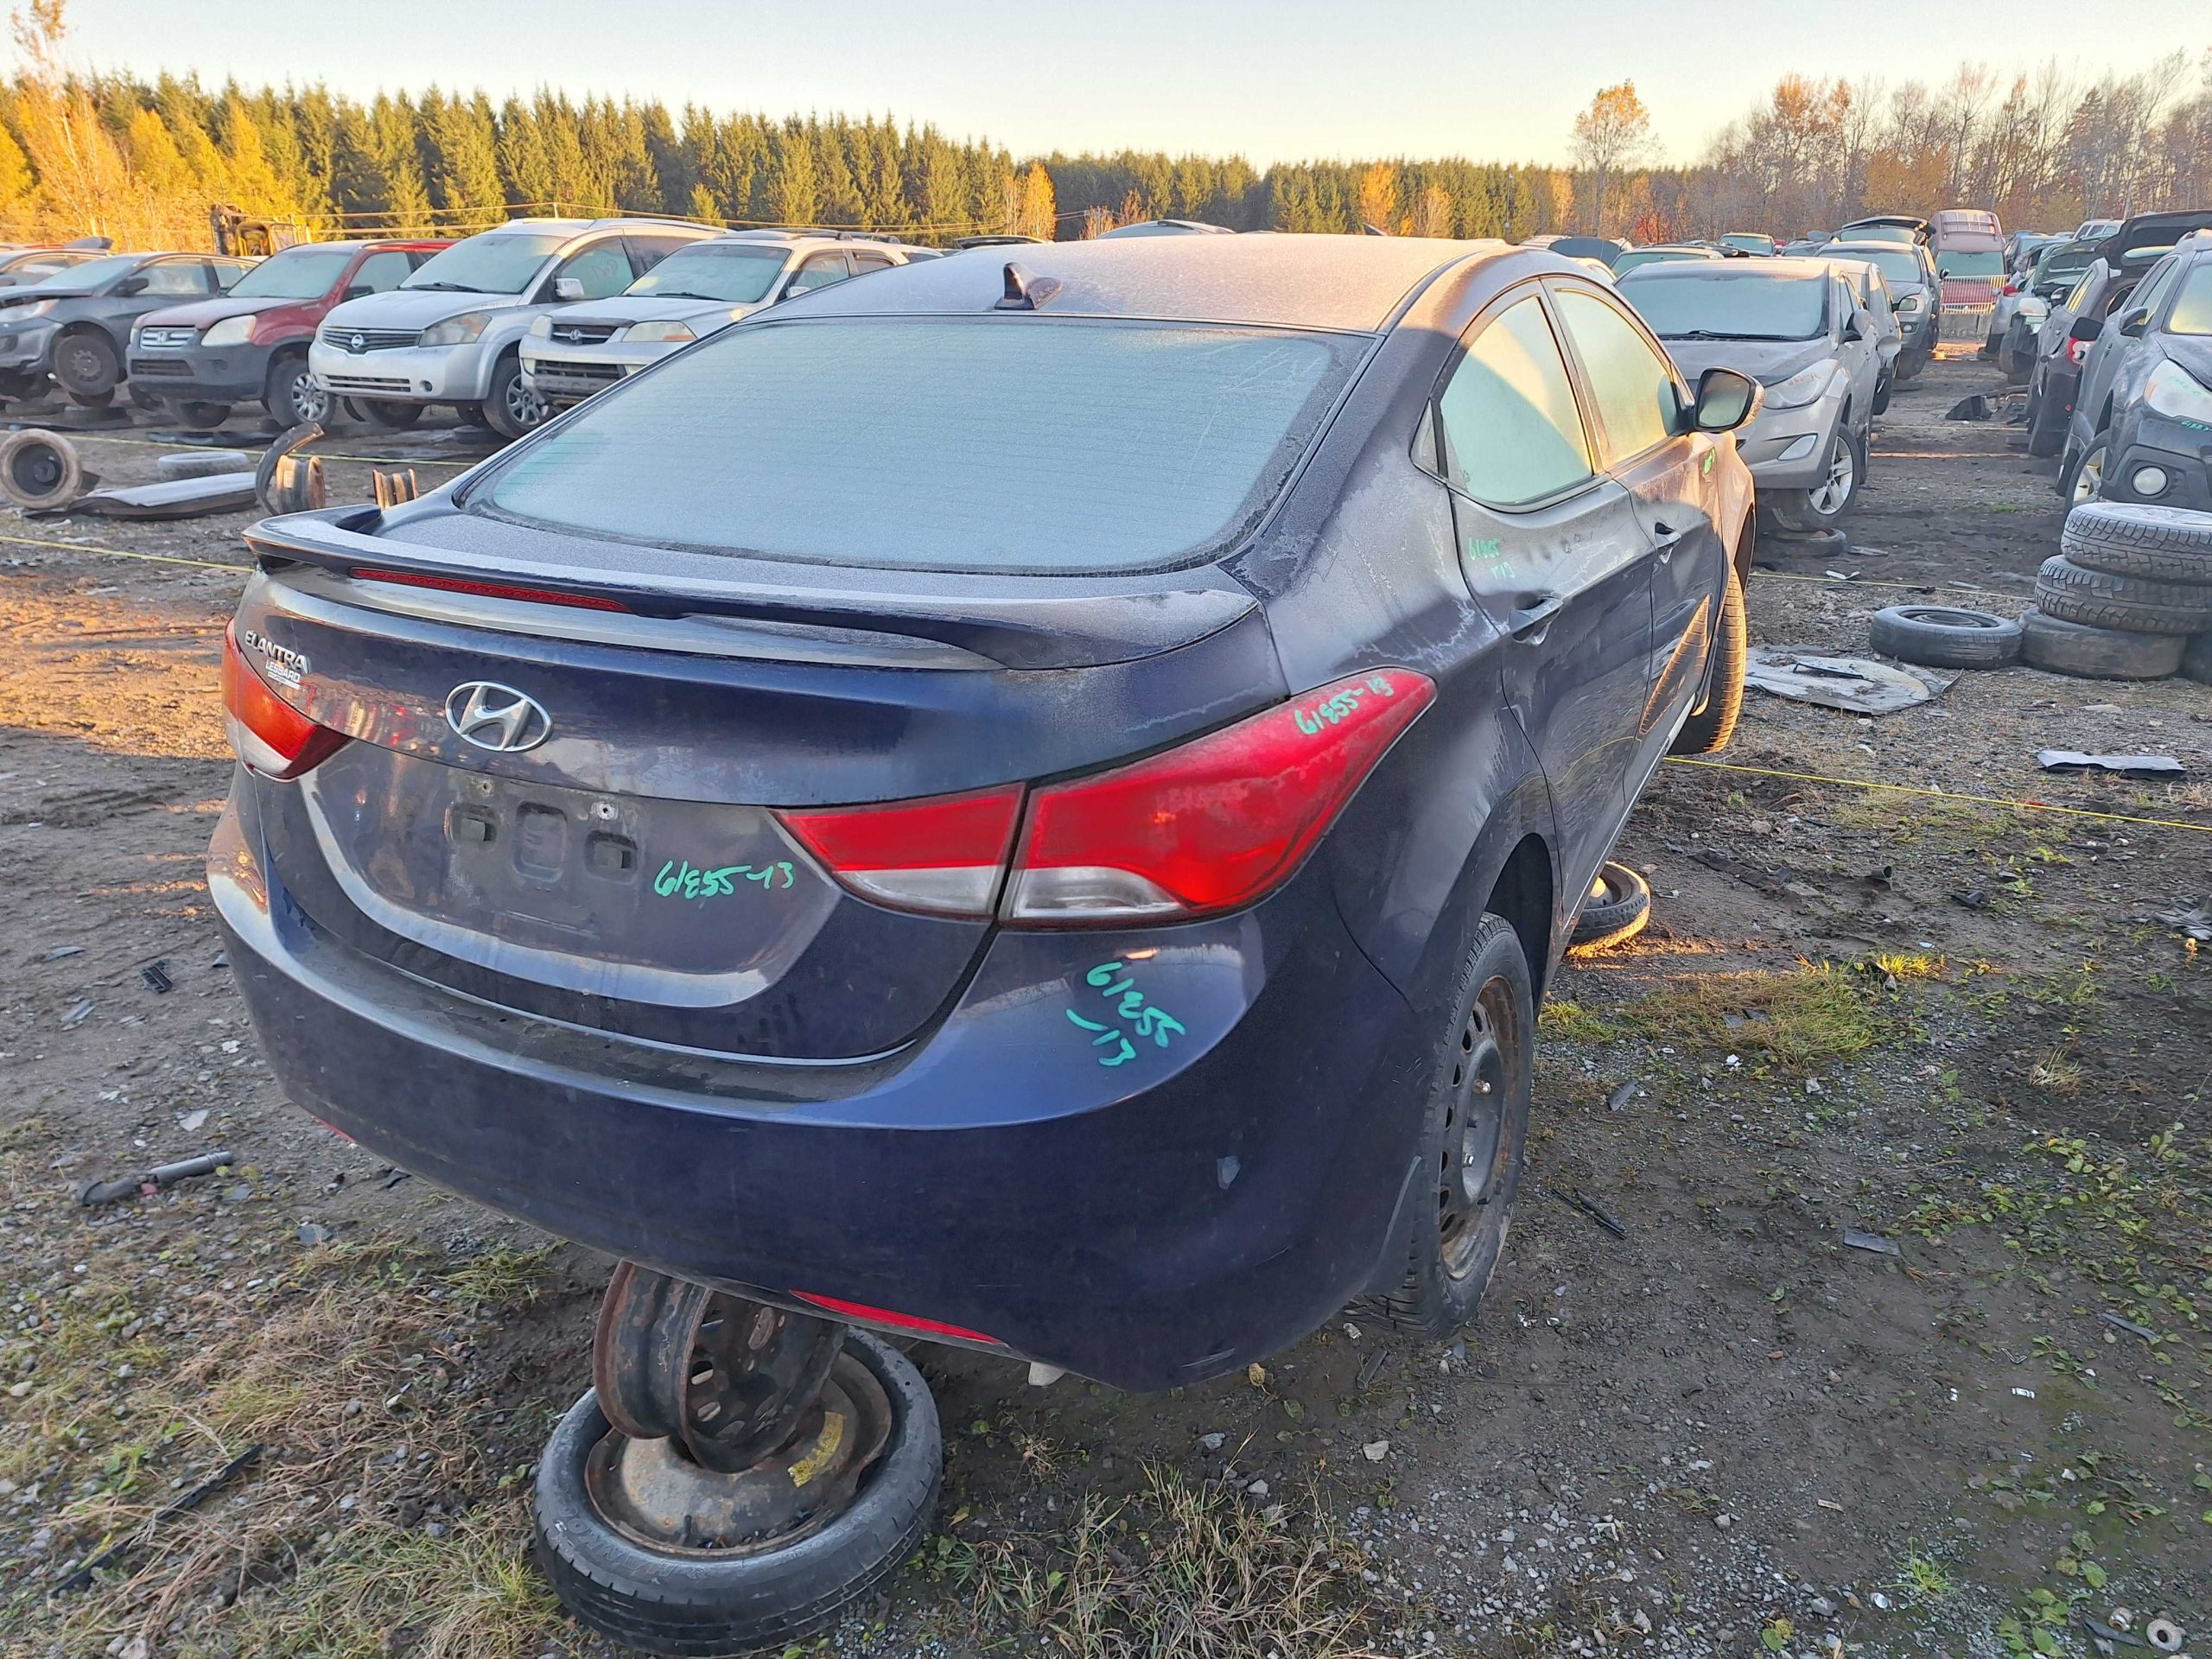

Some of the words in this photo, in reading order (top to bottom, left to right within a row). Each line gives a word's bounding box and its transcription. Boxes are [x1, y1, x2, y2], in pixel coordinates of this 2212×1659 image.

[245, 630, 309, 674] ELANTRA
[265, 659, 301, 683] LESSARD
[557, 1488, 677, 1578] HANKOO
